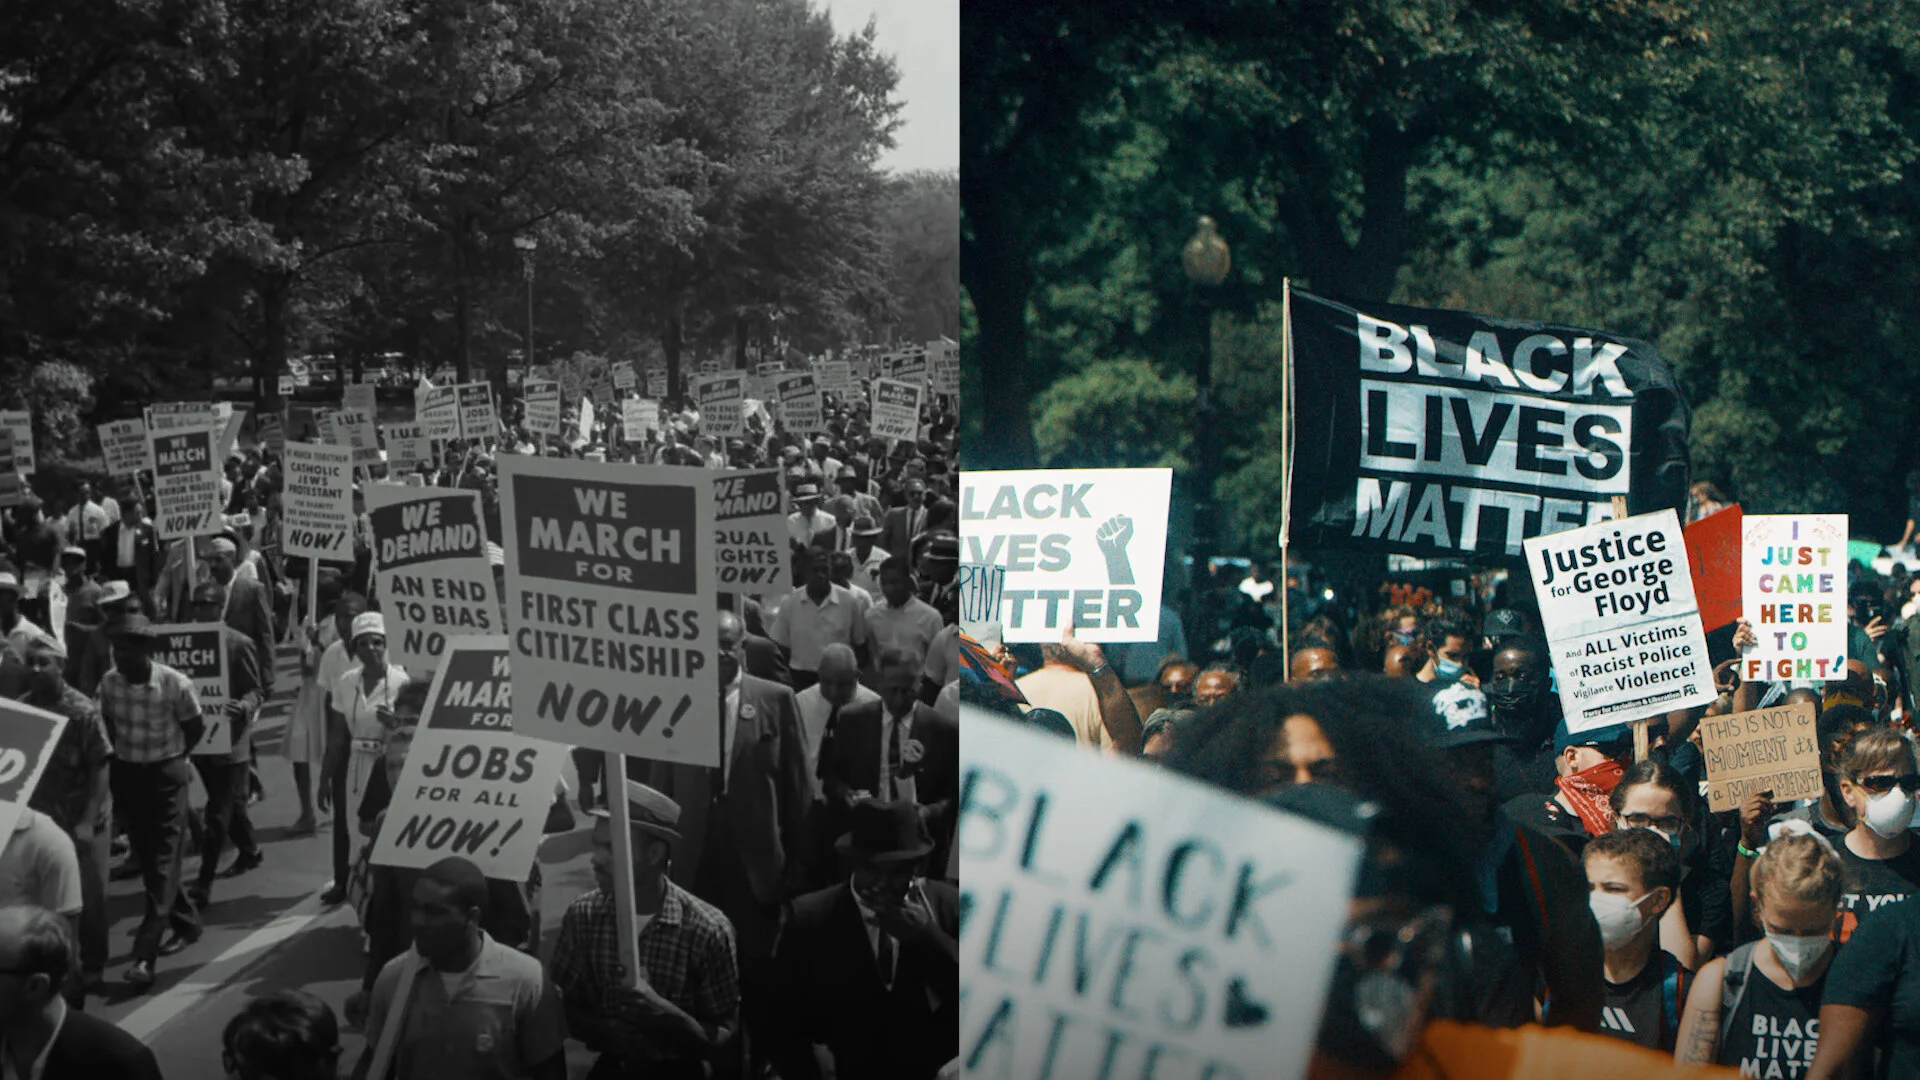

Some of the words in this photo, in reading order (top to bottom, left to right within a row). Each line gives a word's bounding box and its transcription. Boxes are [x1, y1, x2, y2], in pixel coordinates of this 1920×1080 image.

[1356, 312, 1634, 398] BLACK
[706, 422, 740, 432] NOW!
[876, 423, 912, 436] NOW!
[1367, 388, 1624, 481] LIVES
[159, 447, 206, 466] MARCH
[290, 462, 341, 477] CATHOLIC
[288, 483, 344, 500] PROTESTANT
[297, 474, 329, 487] JEWS
[573, 487, 628, 519] WE
[715, 491, 778, 516] MAND
[960, 483, 1096, 521] LACK
[165, 511, 213, 533] NOW!
[402, 502, 442, 531] WE
[288, 529, 346, 551] NOW!
[529, 517, 682, 565] MARCH
[716, 530, 775, 546] QUAL
[1791, 521, 1799, 540] I
[381, 524, 478, 564] DEMAND
[716, 548, 779, 565] IGHTS
[959, 533, 1071, 573] VES
[1761, 546, 1831, 566] JUST
[1540, 529, 1667, 586] Justice
[575, 561, 634, 584] FOR
[716, 566, 781, 585] OW!
[1550, 585, 1572, 598] for
[1573, 557, 1674, 594] George
[1759, 573, 1834, 593] CAME
[390, 574, 426, 599] AN
[433, 577, 487, 600] END
[1595, 580, 1670, 616] Floyd
[397, 601, 426, 623] TO
[430, 603, 491, 629] BIAS
[520, 590, 597, 630] FIRST
[607, 603, 700, 641] CLASS
[1003, 589, 1143, 629] TTER
[1761, 604, 1833, 624] HERE
[169, 634, 193, 649] WE
[403, 628, 446, 656] NO
[517, 627, 706, 679] CITIZENSHIP
[1565, 648, 1582, 659] And
[1585, 639, 1617, 657] ALL
[1620, 624, 1687, 649] Victims
[1773, 632, 1808, 651] TO
[492, 655, 510, 676] W
[1580, 659, 1636, 679] Racist
[1640, 646, 1692, 666] Police
[1748, 655, 1844, 680] FIGHT!
[201, 685, 223, 698] ALL
[444, 680, 513, 708] MAR
[1573, 683, 1614, 700] Vigilante
[1615, 662, 1697, 691] Violence!
[536, 681, 692, 739] NOW!
[1705, 718, 1740, 740] THIS
[1745, 715, 1759, 733] IS
[1762, 710, 1791, 730] NOT
[1797, 714, 1809, 726] a
[422, 744, 538, 784] JOBS
[1707, 735, 1787, 773] MOMENT
[415, 786, 461, 802] FOR
[474, 789, 521, 808] ALL
[395, 814, 524, 857] NOW!
[959, 764, 1296, 954] BLACK
[1865, 893, 1911, 912] YO
[1752, 1013, 1820, 1039] BLAC
[1756, 1036, 1818, 1060] LIVE
